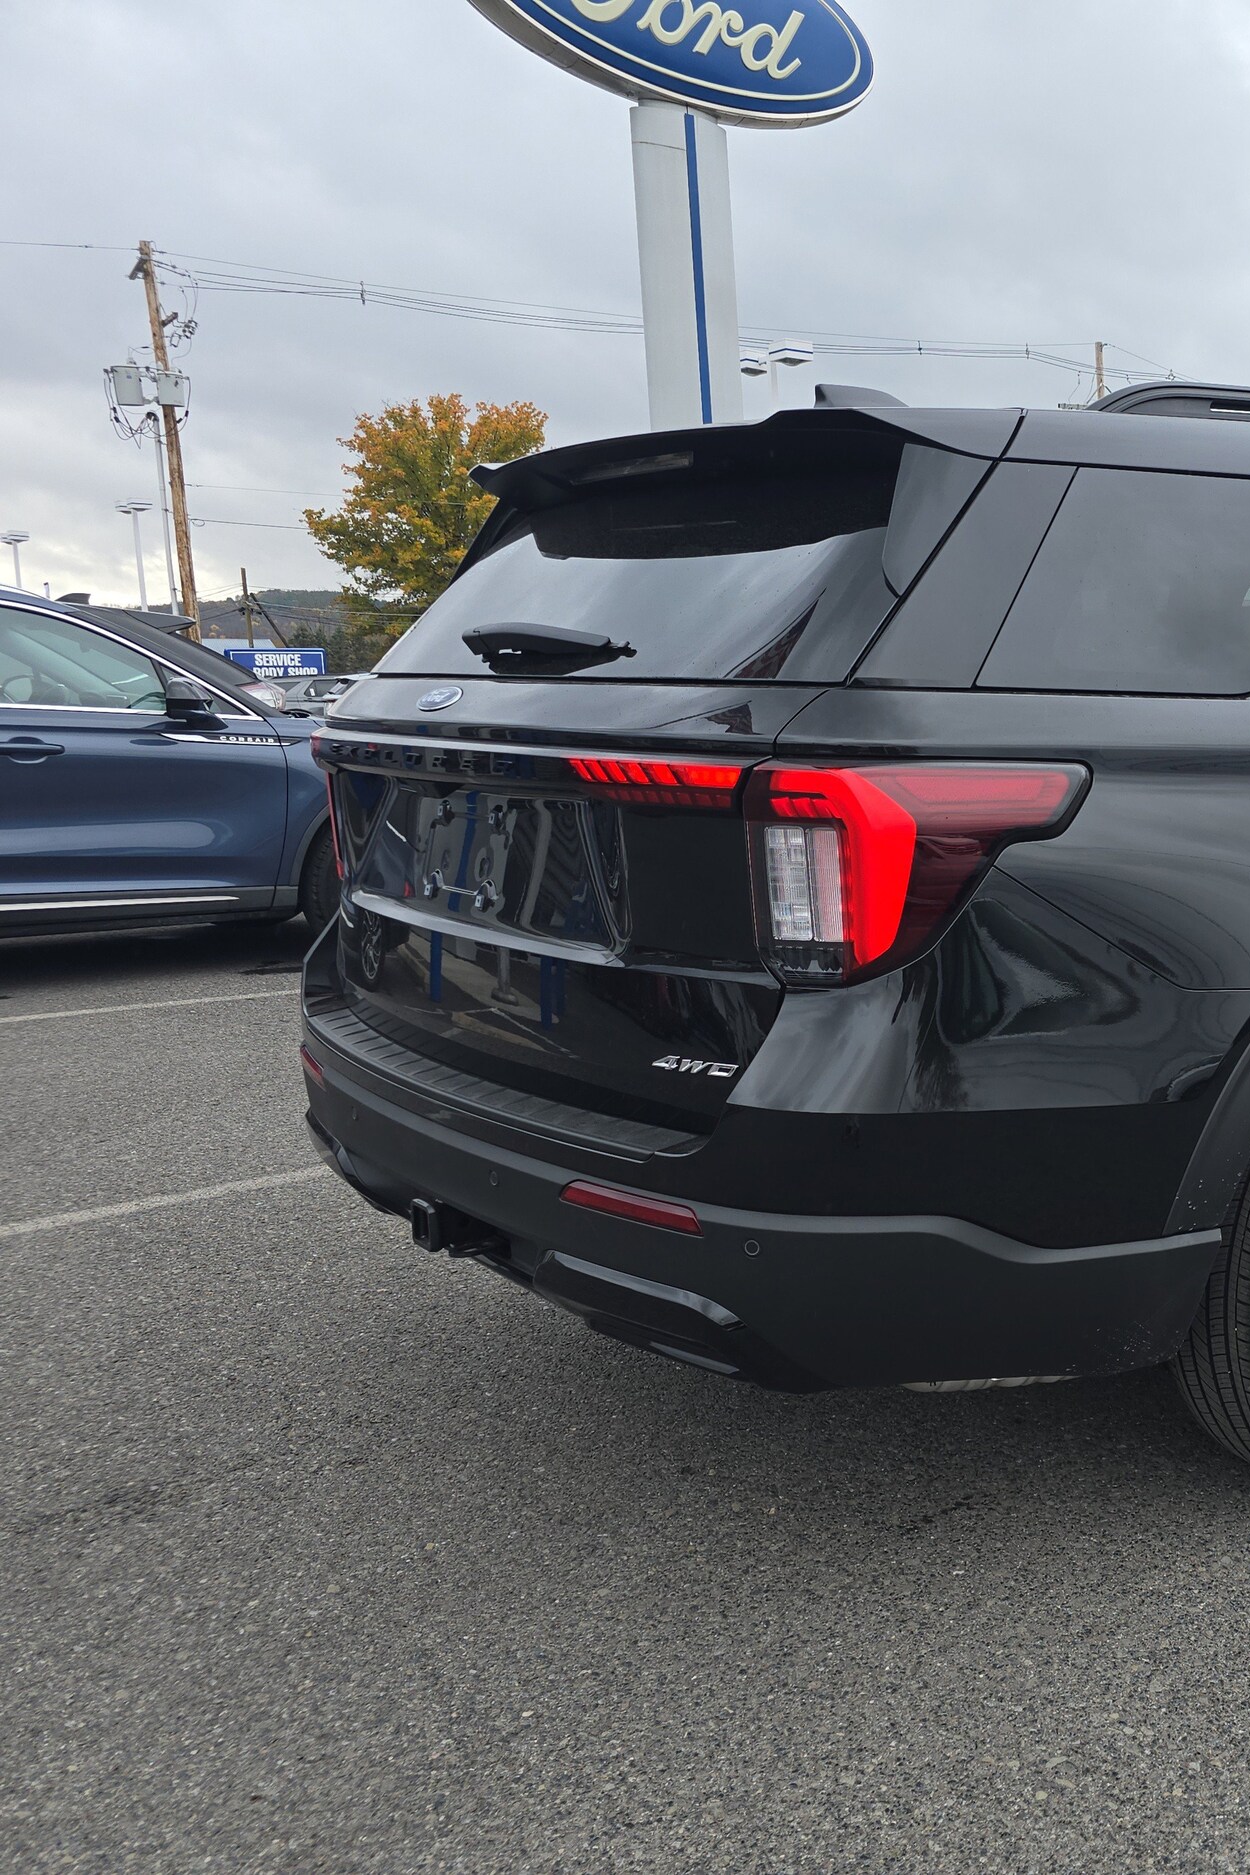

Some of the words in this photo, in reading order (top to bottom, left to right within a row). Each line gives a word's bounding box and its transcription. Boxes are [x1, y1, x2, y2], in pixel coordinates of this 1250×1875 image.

[254, 654, 301, 666] SERVICE
[253, 667, 284, 677] BODY
[288, 667, 318, 676] SHOP
[220, 735, 275, 743] CORSAIR
[331, 743, 514, 774] EXPLORER
[652, 1055, 739, 1077] 4WD
